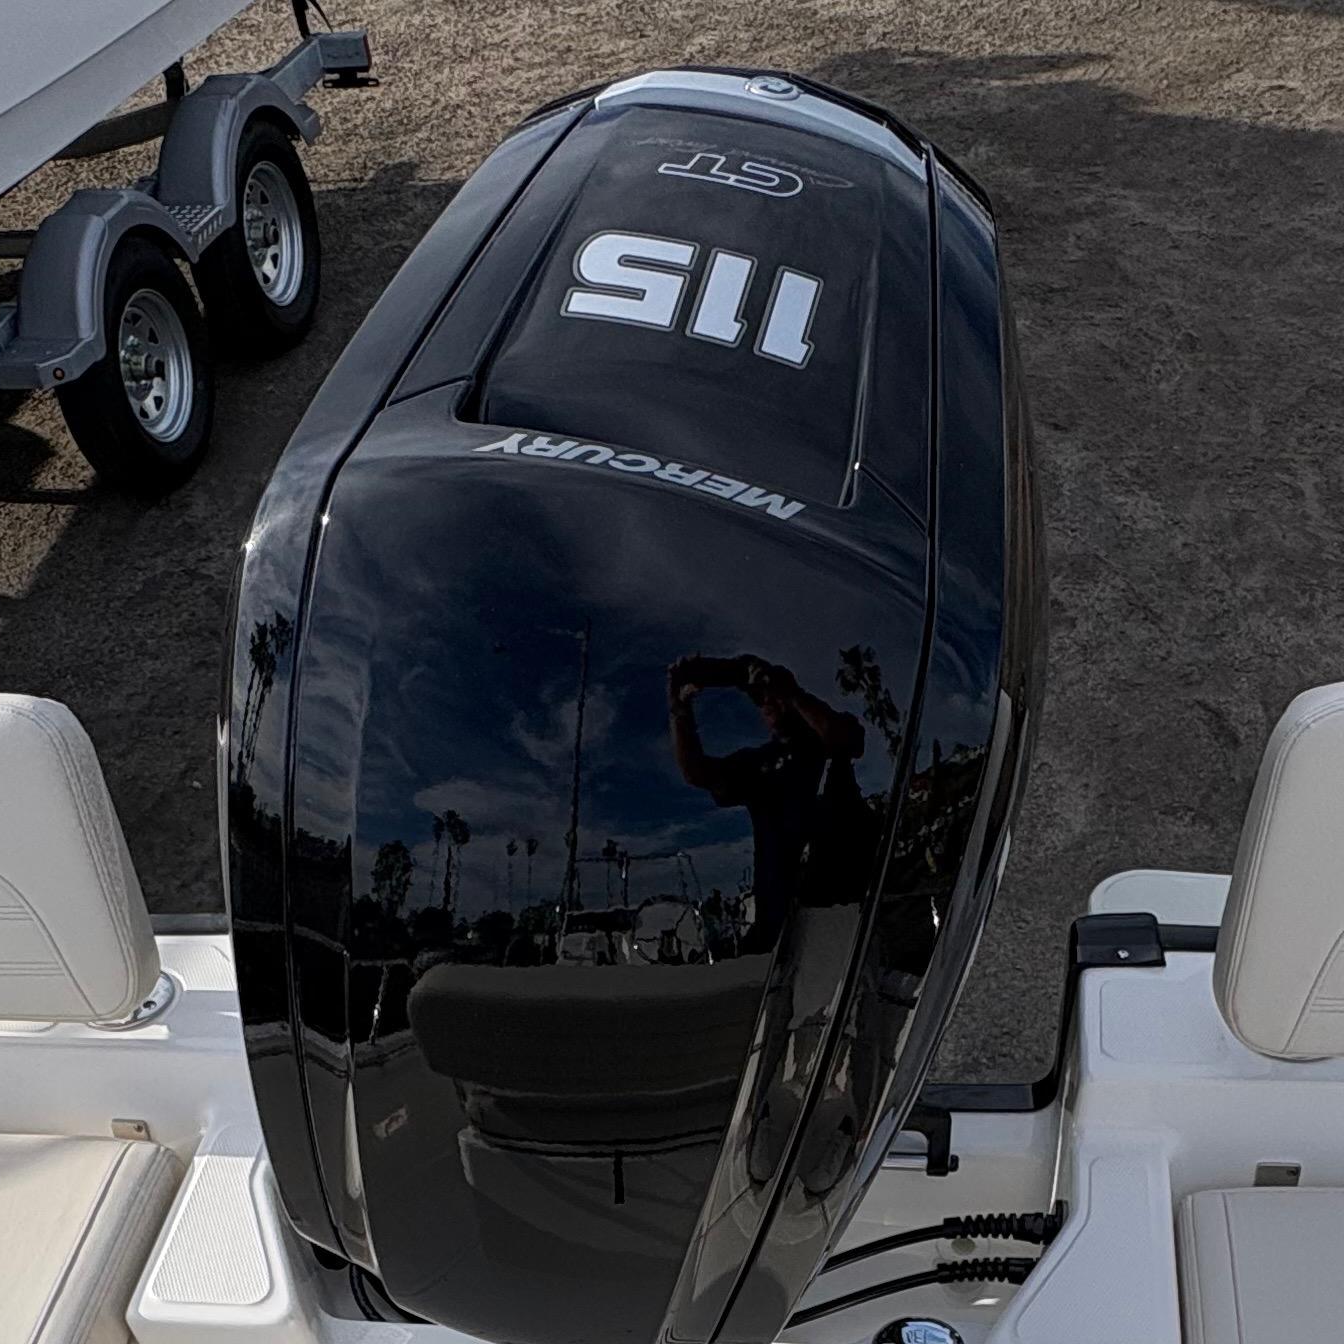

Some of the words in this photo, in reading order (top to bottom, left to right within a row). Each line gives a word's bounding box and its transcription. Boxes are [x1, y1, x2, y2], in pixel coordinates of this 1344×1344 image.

[658, 153, 804, 198] CT
[560, 230, 824, 369] 115
[473, 432, 806, 520] MERCURY
